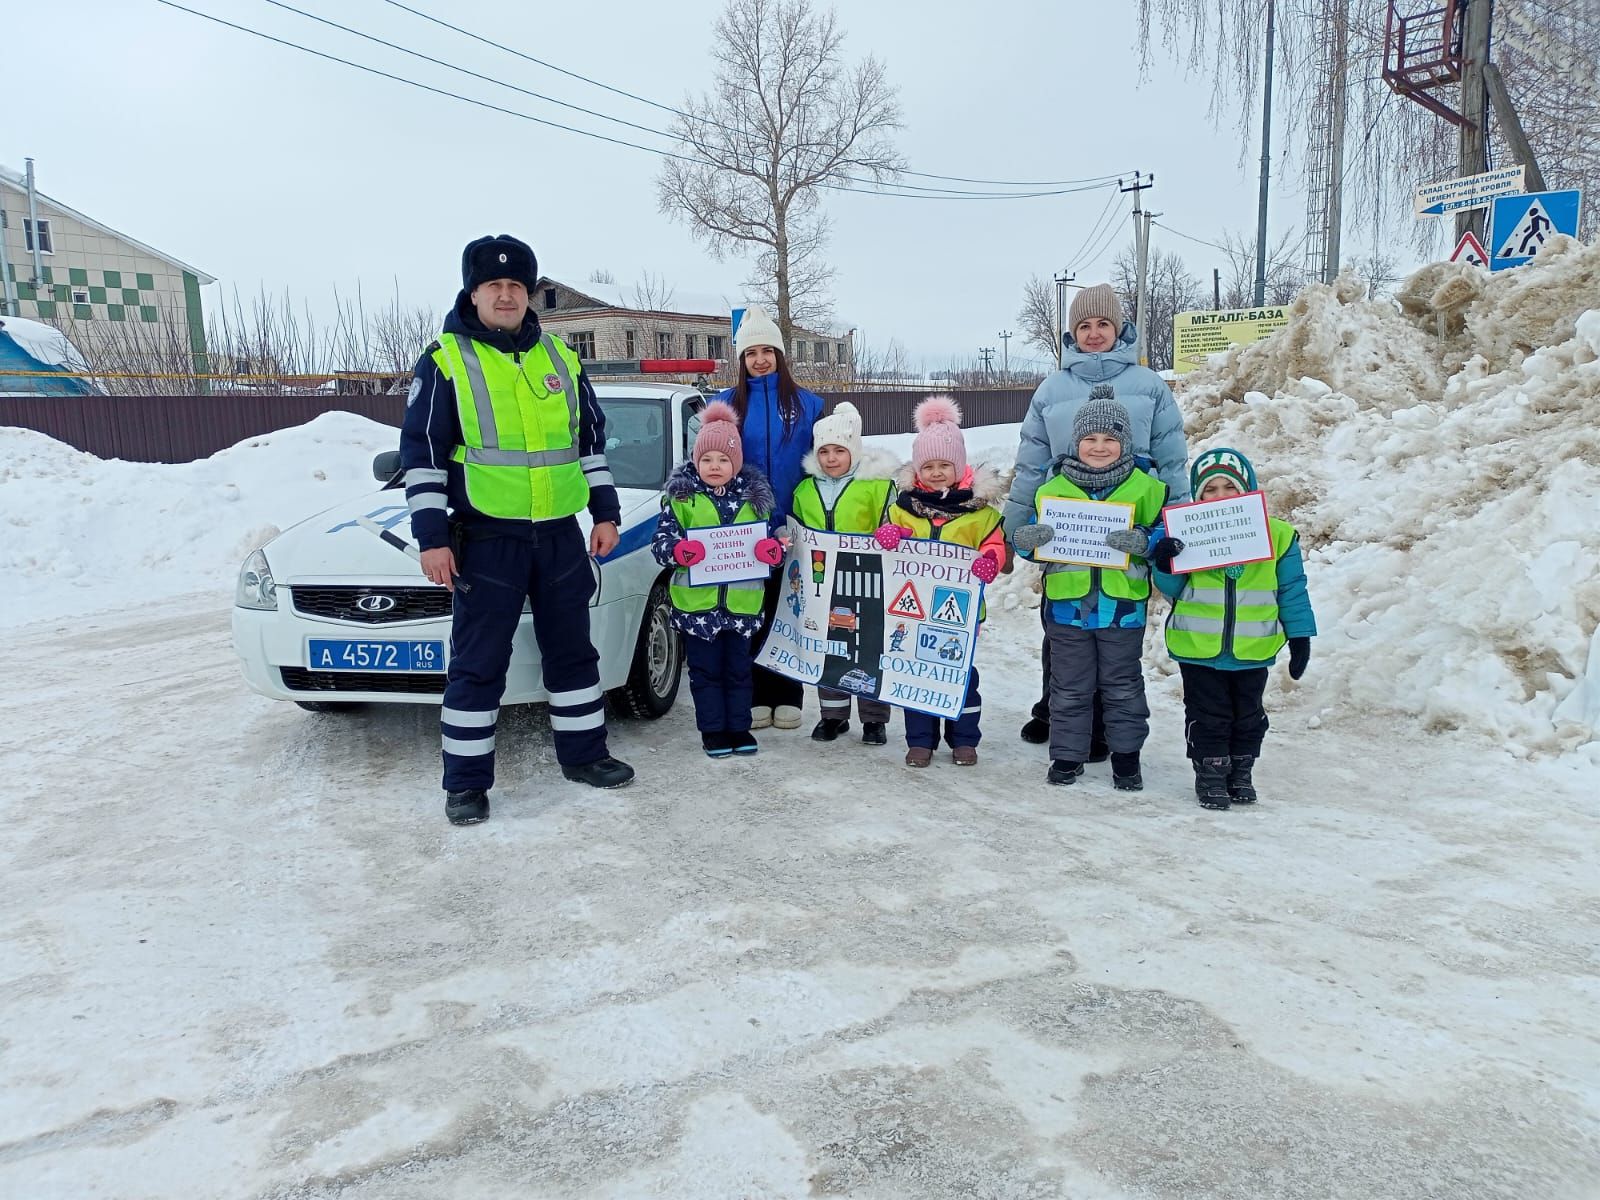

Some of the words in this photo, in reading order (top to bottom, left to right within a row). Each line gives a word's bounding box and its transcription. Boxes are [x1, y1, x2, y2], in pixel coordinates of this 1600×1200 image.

[1418, 186, 1443, 196] СКЛАД
[1426, 192, 1456, 204] ЦЕМЕНТ
[1480, 181, 1512, 192] КРОВЛЯ
[1046, 508, 1076, 519] Будьте
[1184, 505, 1244, 522] ВОДИТЕЛИ
[710, 528, 753, 539] СОХРАНИ
[1189, 517, 1252, 535] РОДИТЕЛИ!
[712, 540, 745, 550] ЖИЗНЬ
[802, 527, 818, 546] ЗА
[1051, 535, 1067, 543] тоб
[1069, 536, 1080, 544] не
[1185, 535, 1227, 548] важайте
[1229, 531, 1257, 541] знаки
[1052, 546, 1111, 560] РОДИТЕЛИ!
[1209, 546, 1232, 557] ПДД
[704, 561, 755, 573] СКОРОСТЬ!
[892, 559, 972, 584] ДОРОГИ
[920, 633, 938, 650] 02
[342, 643, 398, 667] 4572
[413, 643, 435, 661] 16
[777, 650, 820, 677] ВСЕМ
[880, 655, 967, 686] СОХРАНИ
[890, 682, 959, 711] ЖИЗНЬ!
